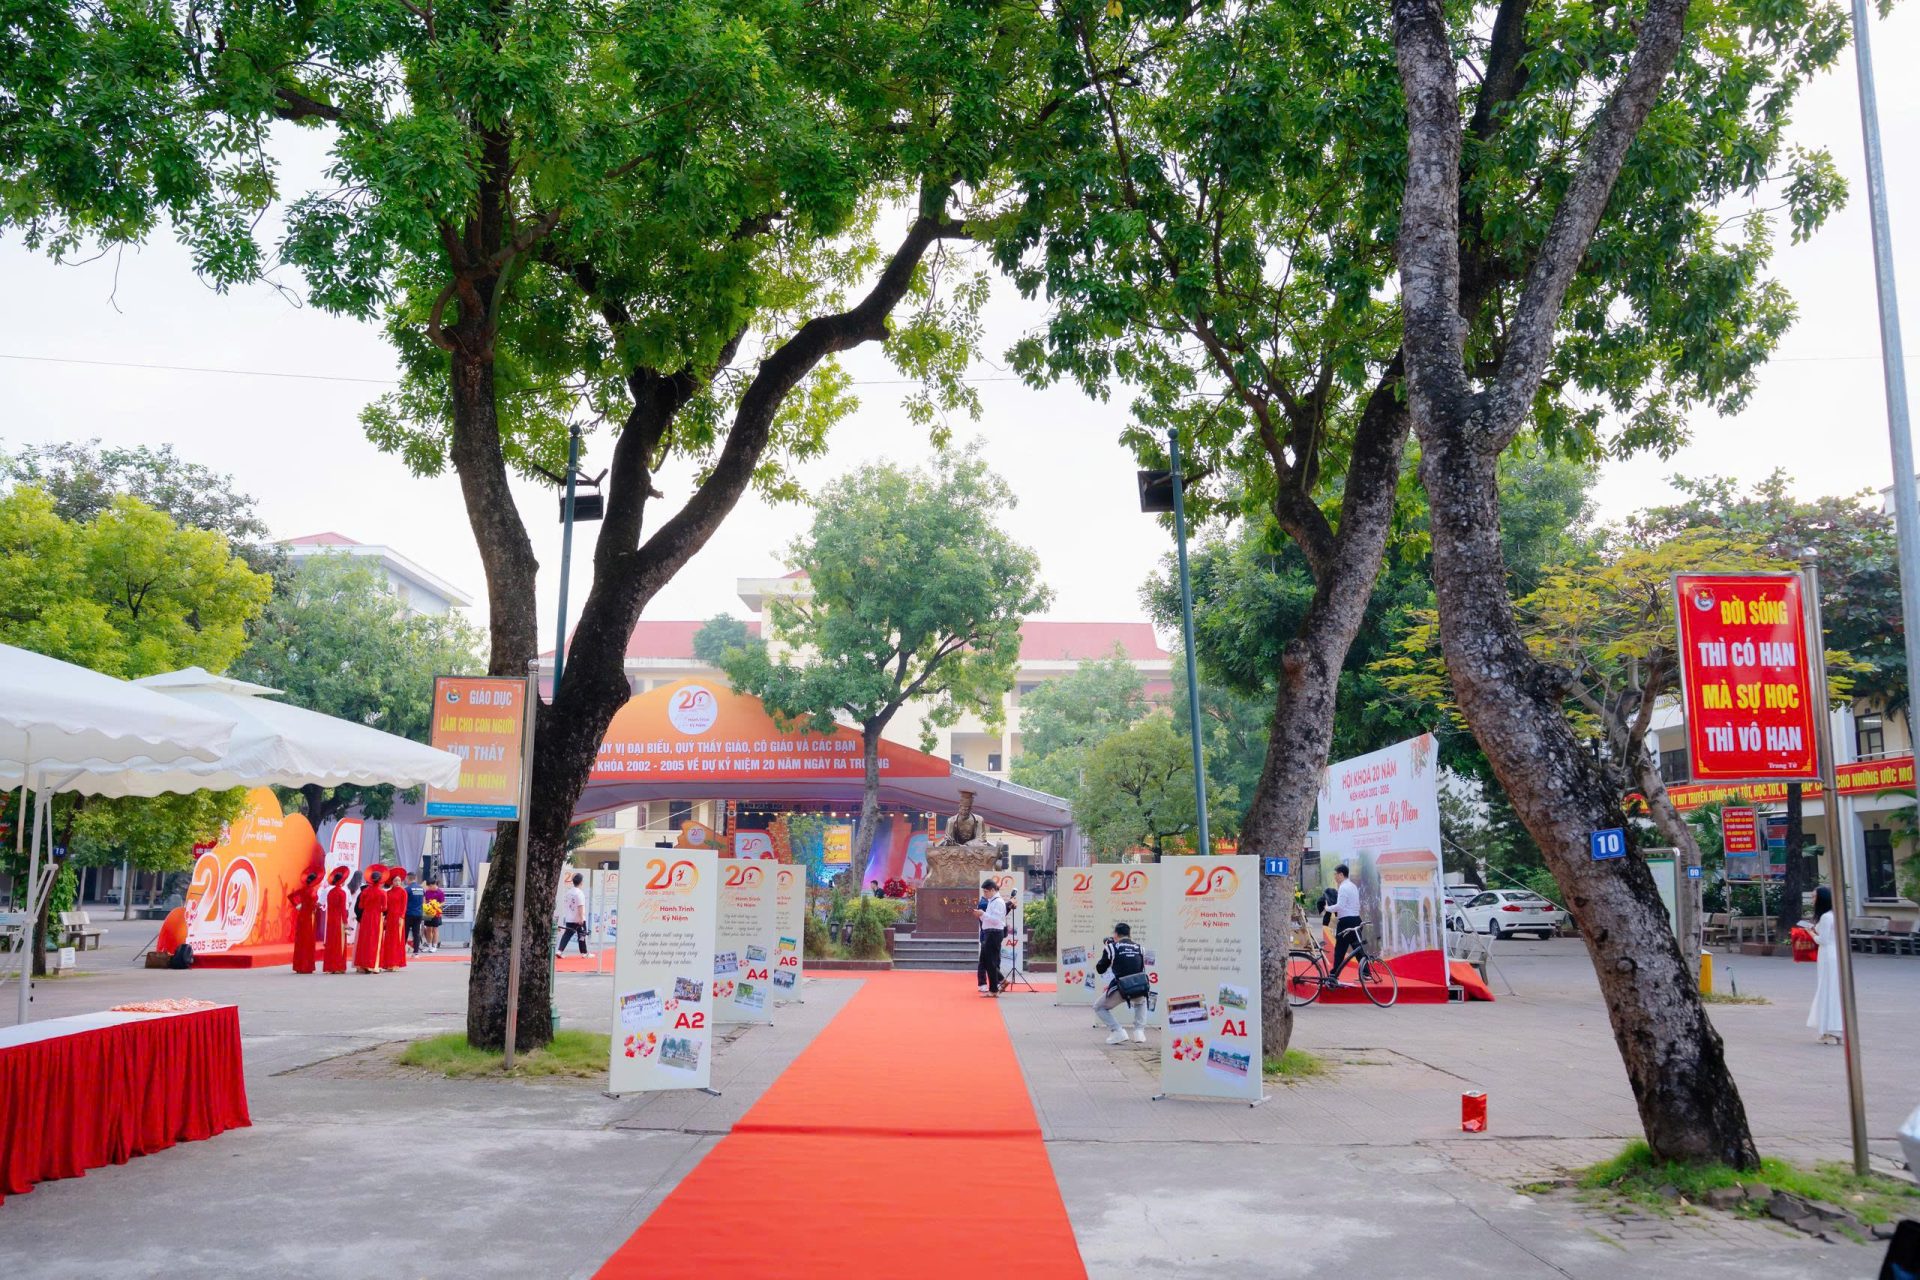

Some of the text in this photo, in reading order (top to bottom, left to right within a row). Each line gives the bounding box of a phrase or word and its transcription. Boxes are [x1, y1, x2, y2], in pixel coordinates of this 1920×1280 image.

[1721, 592, 1788, 624] ĐỜI SỐNG
[1698, 637, 1796, 671] THÌ CÓ HẠN
[470, 688, 512, 709] GIÁO DỤC
[678, 690, 712, 709] 20
[1702, 679, 1799, 714] MÀ SỰ HỌC
[440, 713, 457, 732] LÀM
[459, 717, 473, 733] CHO
[475, 718, 490, 733] CON
[615, 743, 625, 756] VỊ
[628, 742, 645, 756] ĐẠI
[648, 738, 672, 755] BIỂU,
[725, 740, 751, 754] GIÁO,
[754, 739, 767, 752] CÔ
[770, 739, 793, 752] GIÁO
[796, 738, 809, 752] VÀ
[812, 738, 832, 752] CÁC
[835, 740, 855, 754] BẠN
[1705, 721, 1802, 756] THÌ VÔ HẠN
[473, 740, 505, 761] THẤY
[597, 758, 623, 772] KHÓA
[627, 761, 650, 772] 2002
[661, 760, 684, 772] 2005
[687, 757, 699, 771] VỀ
[702, 760, 716, 774] DỰ
[734, 757, 760, 773] NIỆM
[763, 759, 775, 770] 20
[778, 757, 801, 770] NĂM
[804, 757, 831, 770] NGÀY
[834, 758, 847, 769] RA
[1342, 769, 1353, 791] HỘI
[1372, 765, 1380, 782] 20
[1381, 758, 1397, 779] NĂM
[1836, 774, 1850, 788] CHO
[1852, 769, 1878, 787] NHỮNG
[1880, 766, 1897, 784] ƯỚC
[1899, 765, 1913, 782] MƠ
[1597, 833, 1620, 854] 10
[645, 858, 699, 896] 20
[725, 864, 764, 889] 20
[1270, 860, 1283, 873] 11
[1110, 870, 1149, 893] 20
[1185, 865, 1239, 900] 20
[191, 852, 259, 938] 20
[1006, 939, 1019, 947] A7
[779, 956, 798, 966] A6
[746, 968, 768, 980] A4
[1147, 972, 1159, 984] 3
[674, 1012, 705, 1029] A2
[1221, 1019, 1248, 1036] A1
